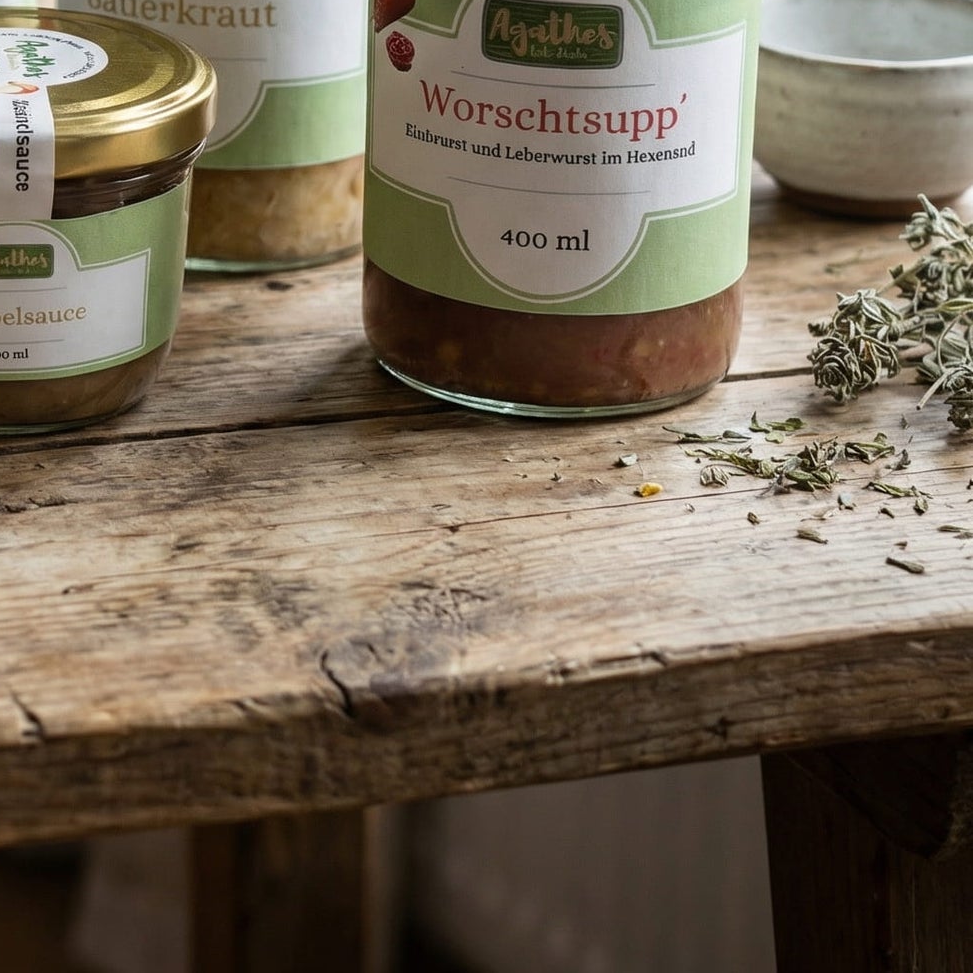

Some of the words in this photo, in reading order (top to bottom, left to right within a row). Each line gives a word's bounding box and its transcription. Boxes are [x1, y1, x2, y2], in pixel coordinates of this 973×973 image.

[488, 8, 618, 57] Agathes
[471, 142, 502, 159] und
[505, 145, 598, 165] Leberwurst
[601, 150, 623, 165] im
[500, 229, 548, 250] 400
[555, 229, 590, 252] ml
[13, 348, 29, 360] ml
